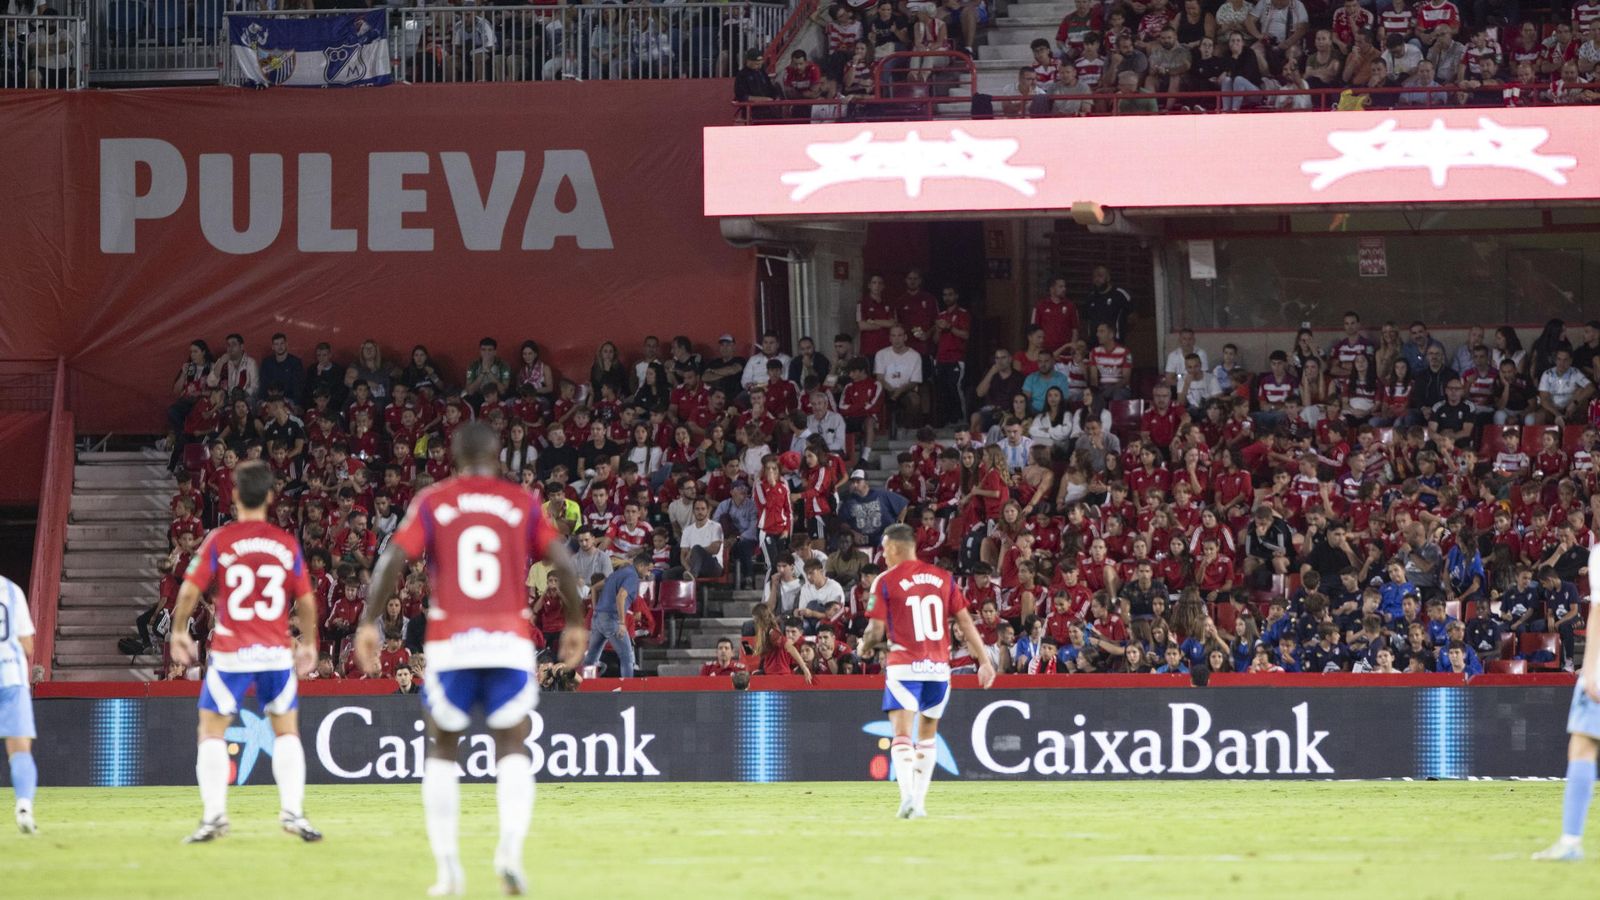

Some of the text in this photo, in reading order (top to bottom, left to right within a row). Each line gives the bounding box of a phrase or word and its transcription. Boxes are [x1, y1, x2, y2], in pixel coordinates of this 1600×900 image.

[99, 137, 615, 255] PULEVA
[225, 563, 287, 621] 23
[457, 525, 501, 600] 6
[905, 594, 945, 642] 10
[971, 700, 1335, 774] CaixaBank
